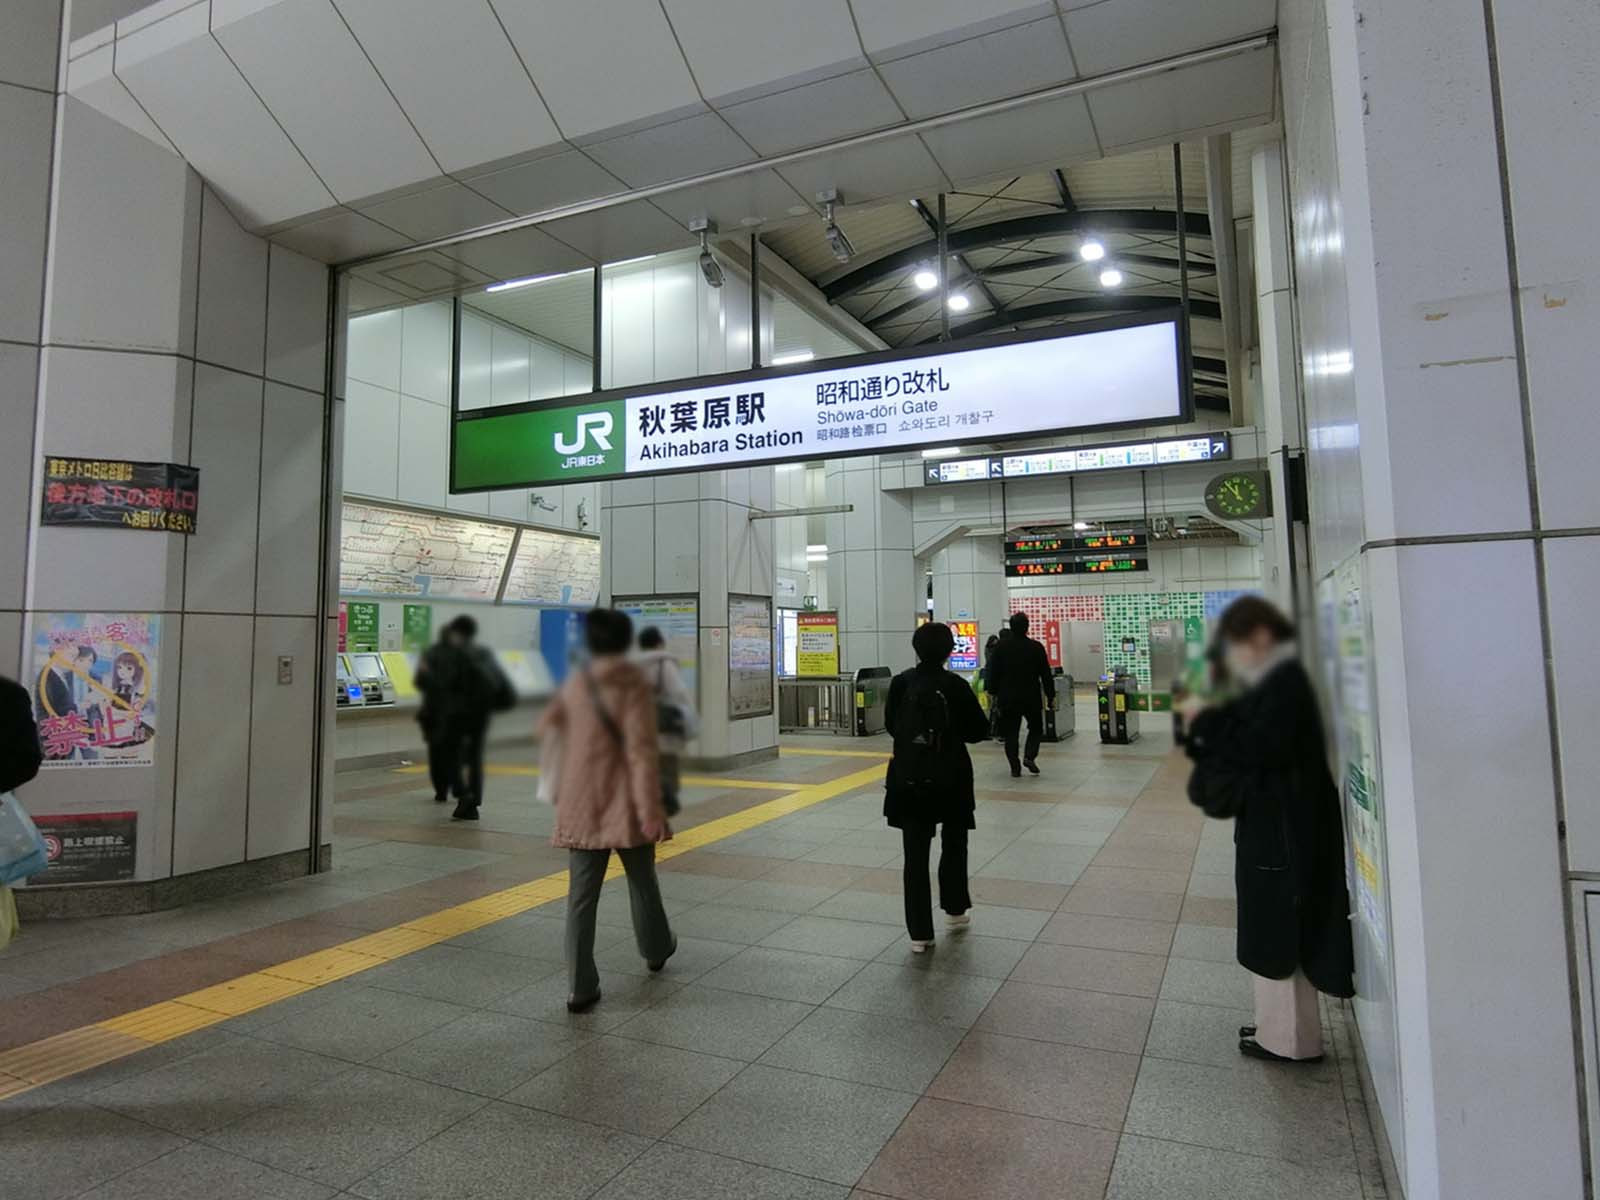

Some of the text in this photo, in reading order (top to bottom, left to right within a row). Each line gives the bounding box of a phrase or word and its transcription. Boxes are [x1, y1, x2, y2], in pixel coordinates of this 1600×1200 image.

[816, 367, 950, 406] 昭和通り改札
[639, 392, 765, 437] 秋葉原駅
[817, 400, 938, 425] Shōwa-dōri Gate
[898, 410, 994, 432] 쇼와도리 개찰구
[554, 411, 614, 455] JR
[639, 429, 803, 461] Akihabara Station
[40, 706, 135, 756] 禁止
